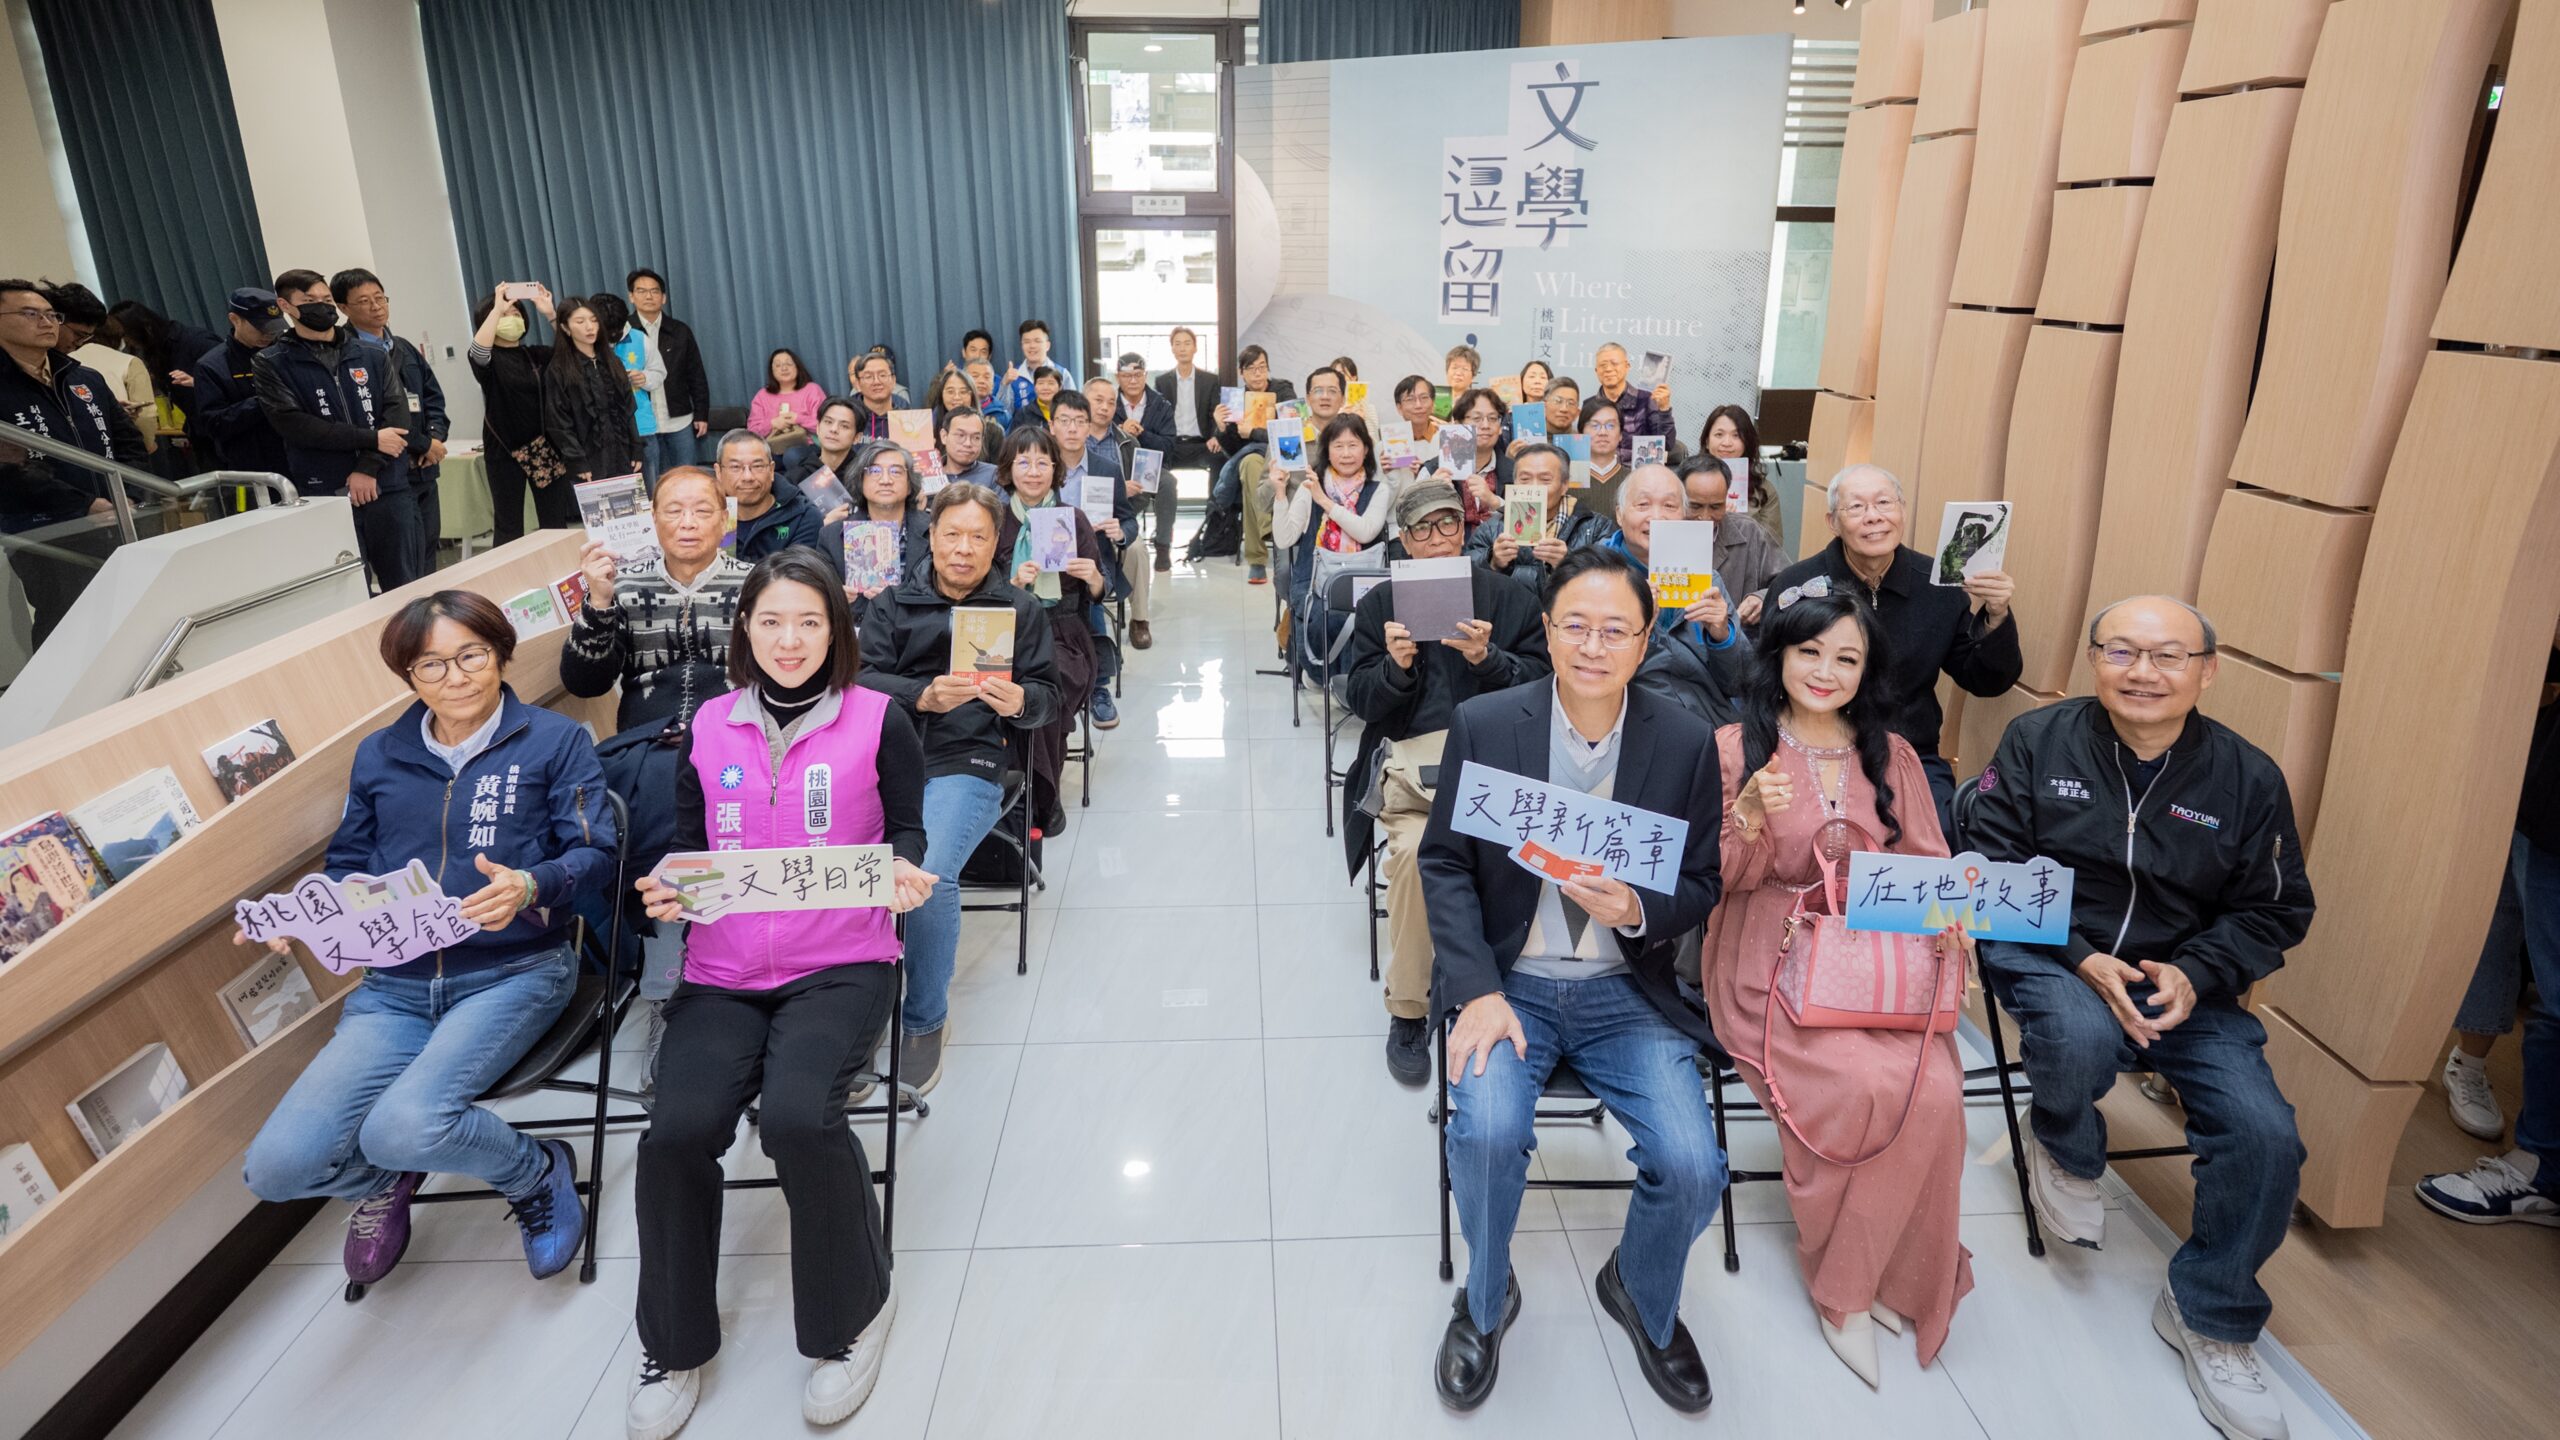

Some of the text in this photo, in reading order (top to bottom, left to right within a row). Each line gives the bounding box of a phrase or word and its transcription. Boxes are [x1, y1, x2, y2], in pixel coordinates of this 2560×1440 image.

[1515, 61, 1600, 251] 文學
[1534, 271, 1632, 299] Where
[1559, 307, 1703, 337] Literature
[315, 388, 331, 416] 保民組
[356, 386, 377, 431] 桃園分
[502, 764, 520, 815] 桃園市議員
[808, 769, 827, 828] 桃園區
[2050, 778, 2083, 789] 文化局長
[2058, 787, 2091, 799] 邱正生
[466, 774, 502, 850] 黃婉如
[1465, 783, 1674, 881] 文學新篇章
[2169, 803, 2221, 828] TAOYUAN
[739, 851, 882, 902] 文學日常
[1859, 865, 2060, 929] 在地故事
[240, 880, 344, 938] 桃園
[322, 900, 474, 972] 文學館
